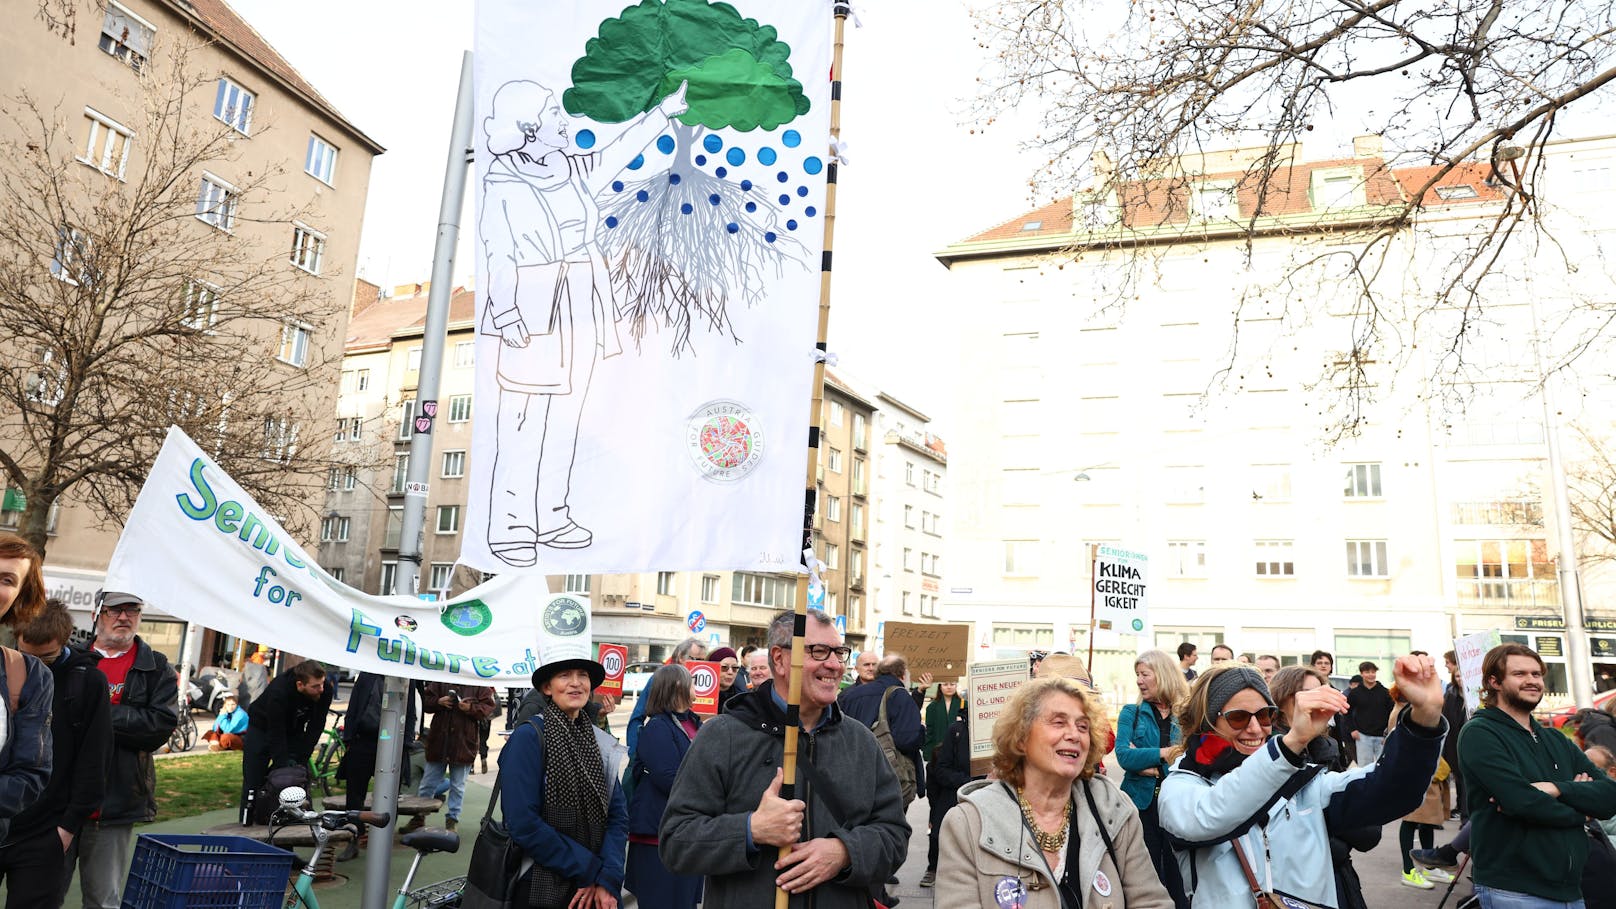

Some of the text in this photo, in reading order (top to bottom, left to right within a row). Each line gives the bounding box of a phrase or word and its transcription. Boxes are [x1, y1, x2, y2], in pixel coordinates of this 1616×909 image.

[1100, 562, 1141, 580] KLIMA
[253, 566, 302, 607] for
[1095, 580, 1146, 597] GERECHT
[46, 585, 92, 605] video
[1105, 595, 1138, 609] IGKEIT
[890, 627, 951, 640] FREIZEIT
[928, 646, 949, 654] EIN
[606, 657, 620, 671] 100
[693, 673, 712, 687] 100
[977, 683, 998, 692] KEINE
[990, 696, 1005, 704] UND
